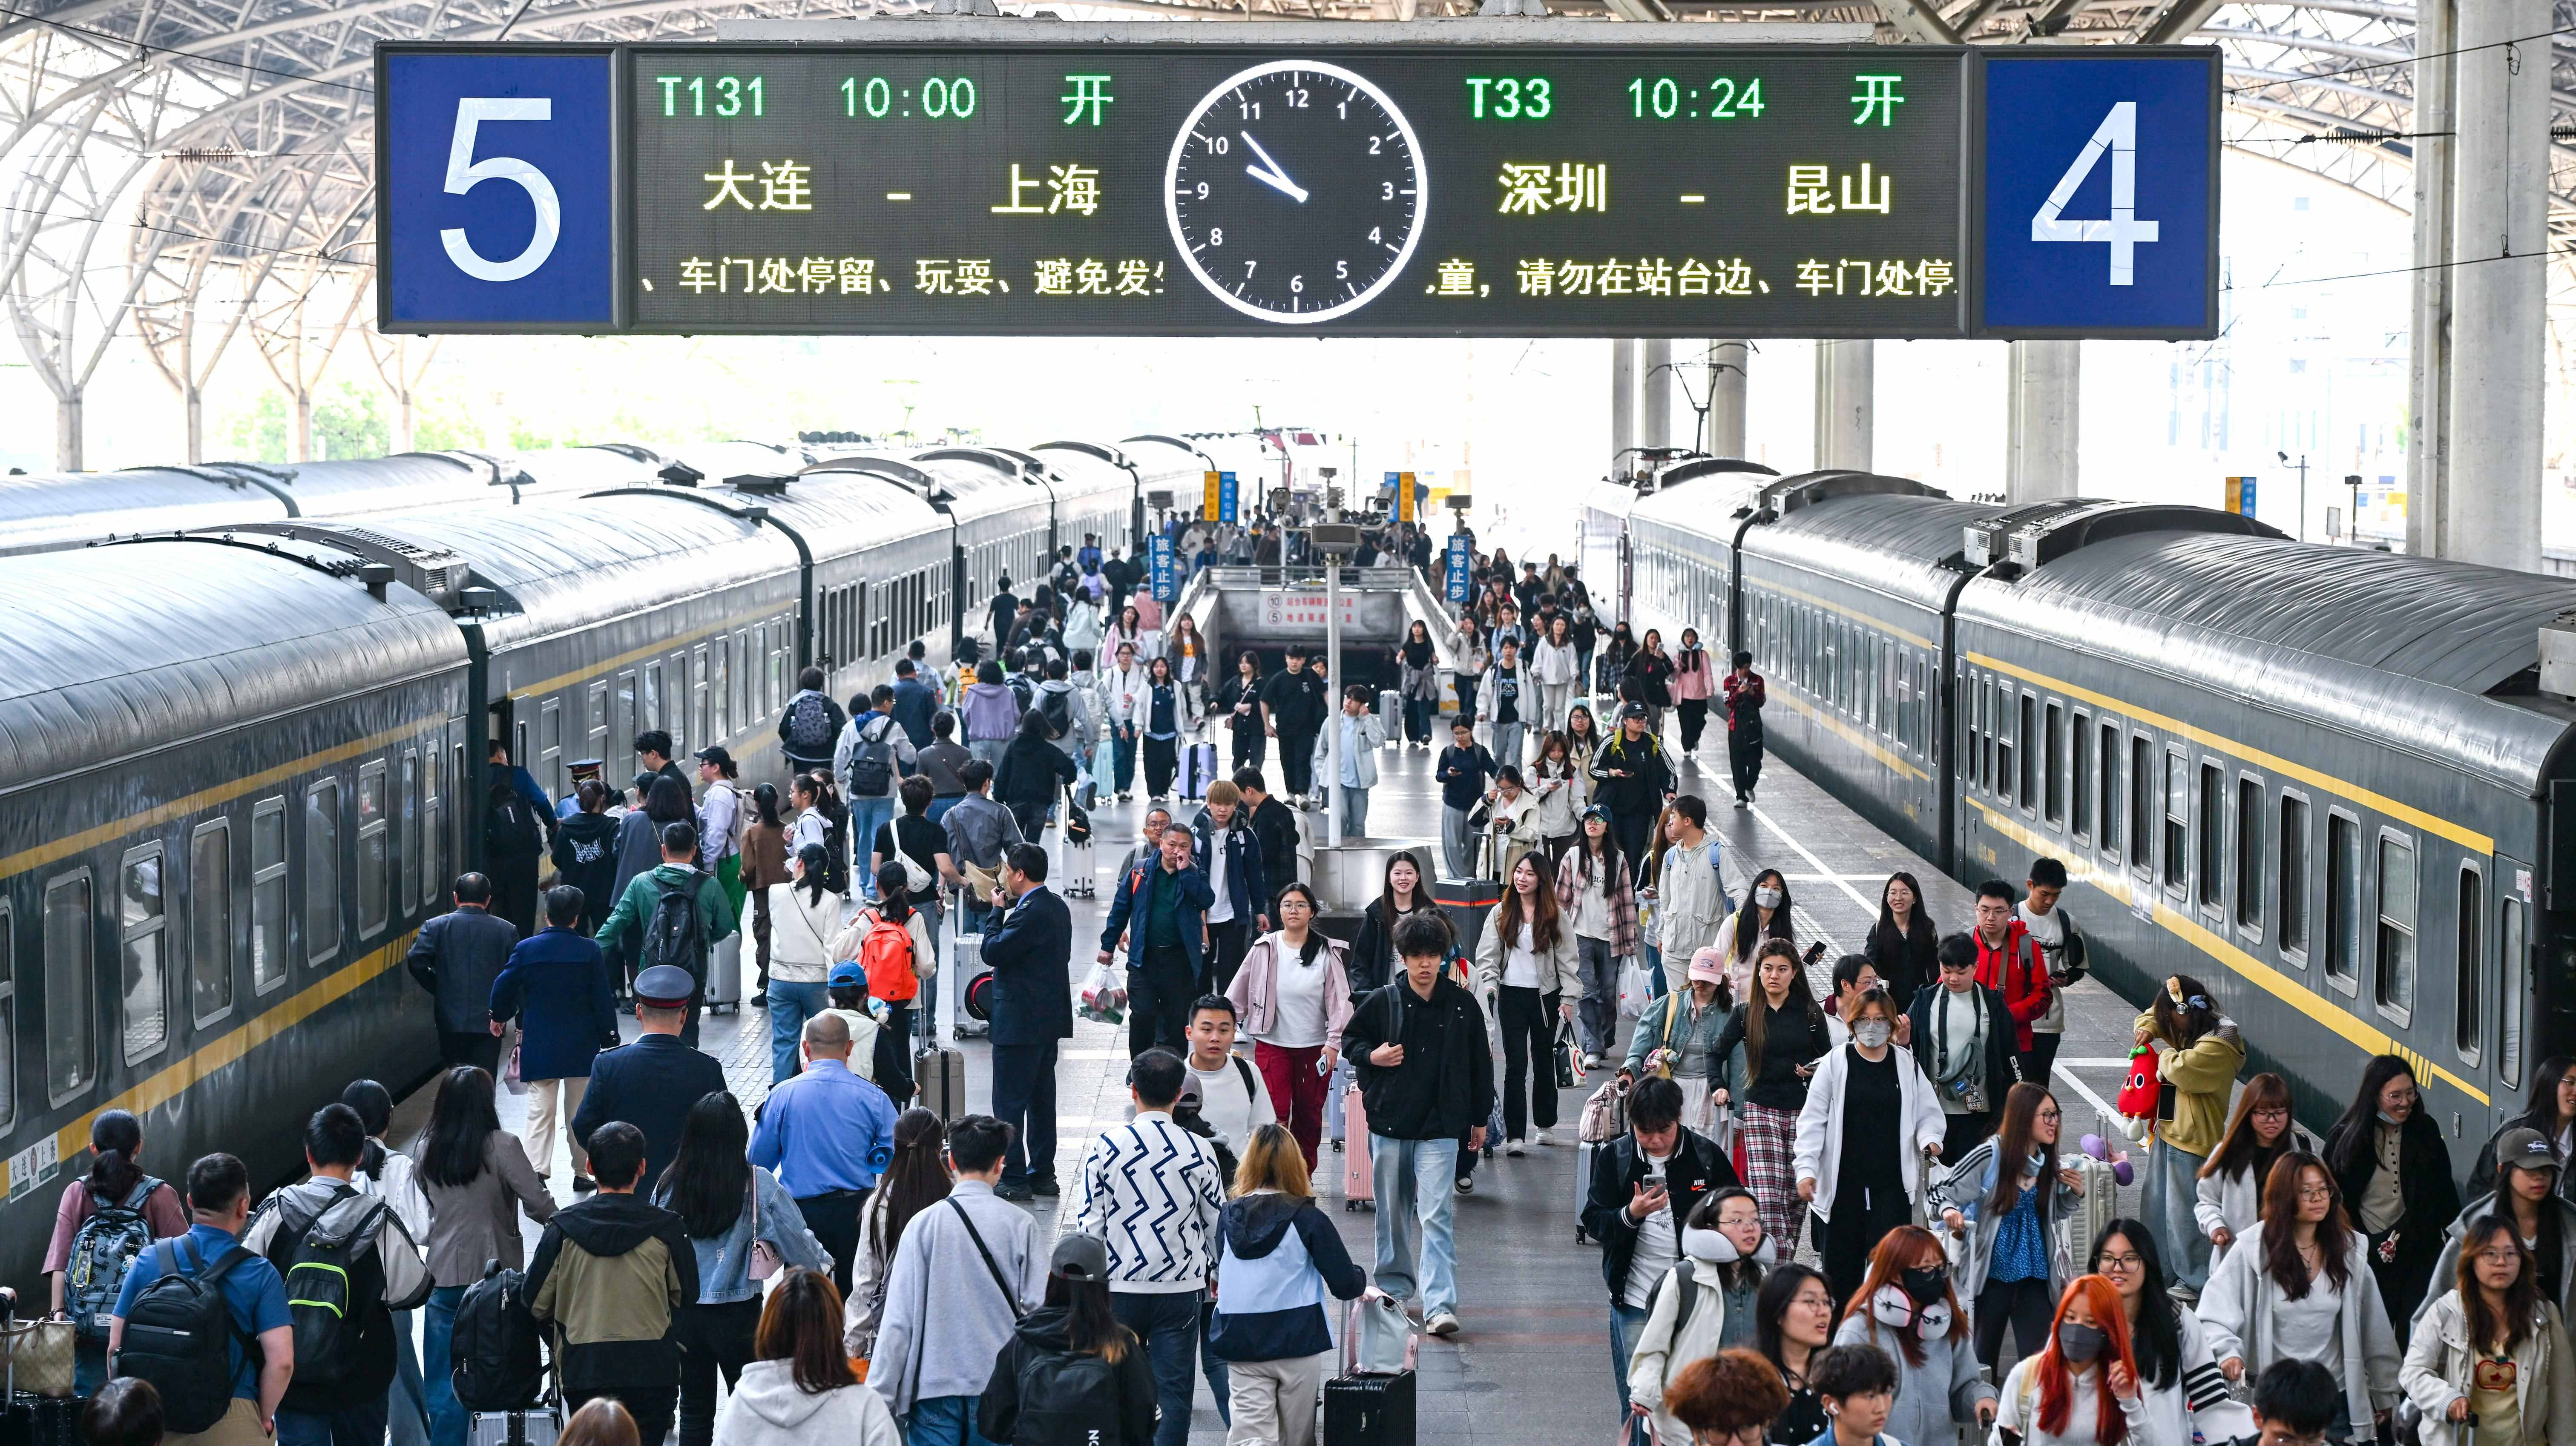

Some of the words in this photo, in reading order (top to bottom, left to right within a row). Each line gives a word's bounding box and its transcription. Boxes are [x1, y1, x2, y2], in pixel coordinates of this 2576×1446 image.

[657, 77, 764, 117] T131
[841, 77, 976, 118] 10:00
[1061, 76, 1114, 126] 开
[1285, 89, 1309, 107] 12
[1466, 78, 1551, 118] T33
[1629, 78, 1765, 118] 10:24
[1851, 76, 1904, 126] 开
[1239, 102, 1260, 120] 11
[1337, 102, 1346, 120] 1
[1205, 136, 1228, 155] 10
[1369, 136, 1381, 155] 2
[440, 98, 560, 281] 5
[703, 159, 812, 210] 大连
[991, 164, 1100, 215] 上海
[1197, 182, 1209, 200] 9
[1382, 181, 1393, 200] 3
[1499, 163, 1606, 215] 深圳
[1786, 163, 1890, 215] 昆山
[2032, 102, 2159, 285] 4
[1210, 227, 1222, 246] 8
[1368, 226, 1381, 244] 4
[1245, 261, 1257, 279] 7
[1336, 261, 1348, 279] 5
[1426, 258, 1954, 298] 童，请勿在站台边、车门处停
[1291, 275, 1303, 293] 6
[1156, 538, 1170, 599] 旅客止步
[1451, 538, 1465, 599] 旅客止步
[1271, 597, 1279, 606] 10
[1272, 613, 1278, 623] 5
[11, 1155, 27, 1184] 大连
[40, 1139, 56, 1166] 上海
